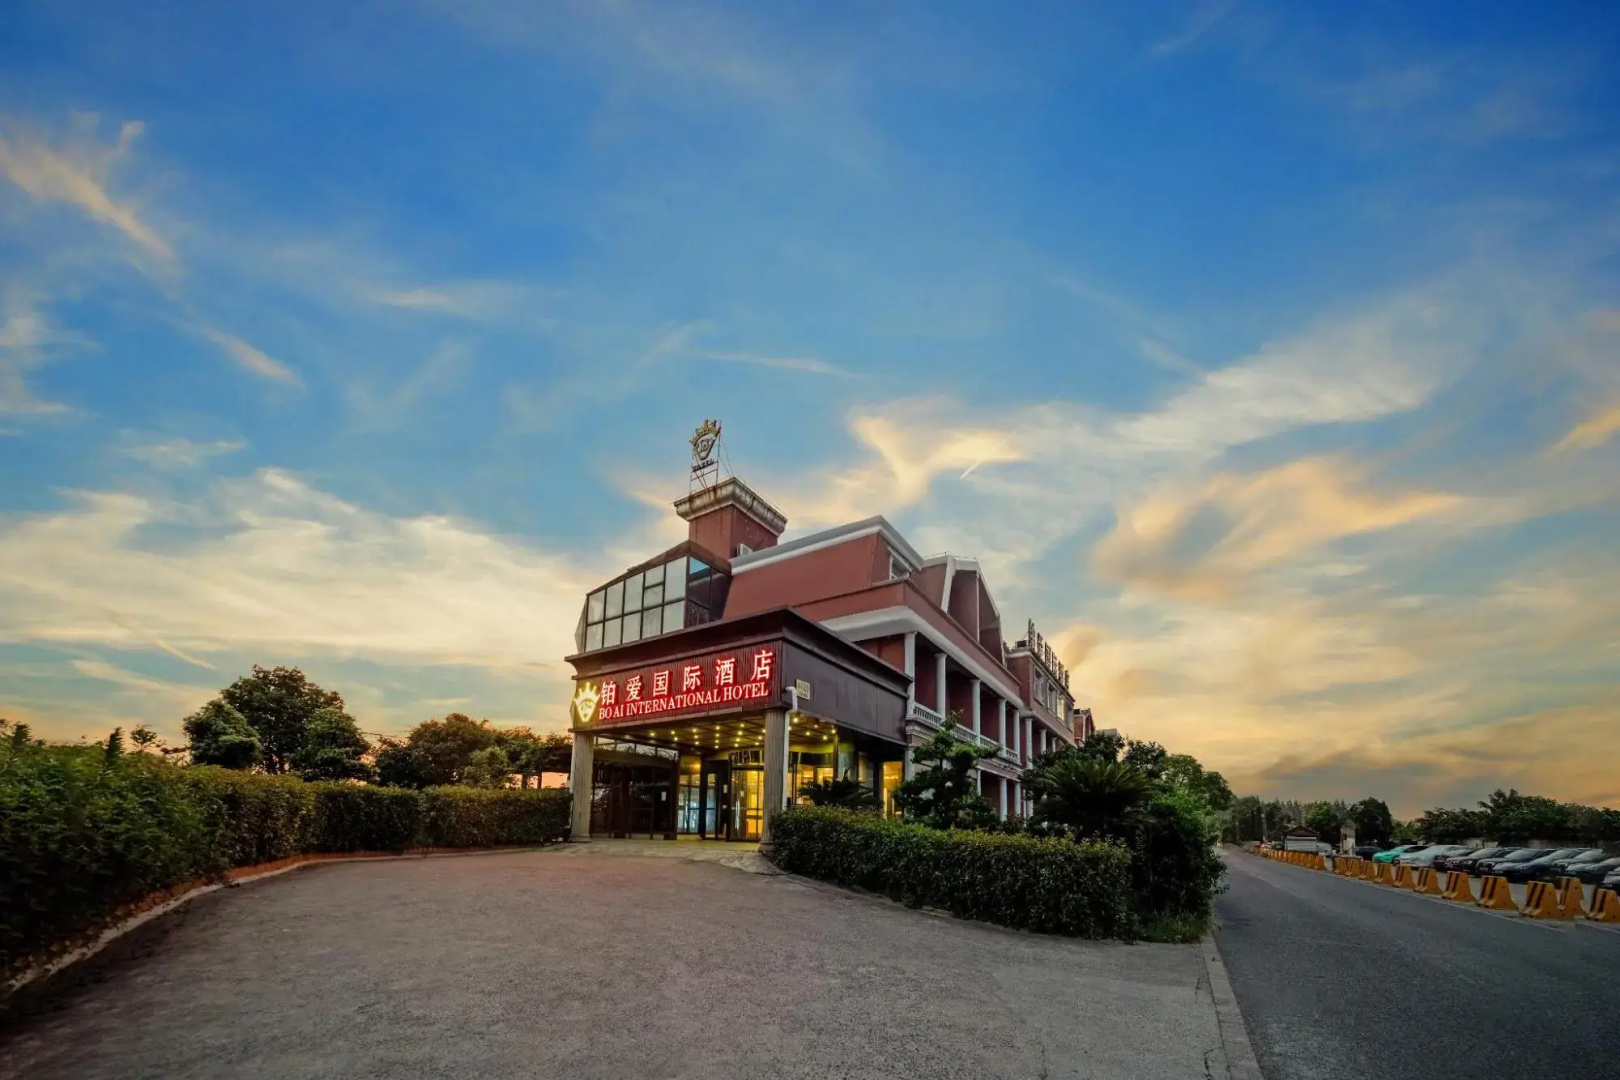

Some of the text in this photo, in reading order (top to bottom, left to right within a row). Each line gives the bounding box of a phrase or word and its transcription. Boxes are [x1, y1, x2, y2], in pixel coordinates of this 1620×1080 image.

[601, 650, 773, 705] 铂爱国际酒店
[626, 689, 720, 716] INTERNATIONAL
[723, 682, 769, 701] HOTEL
